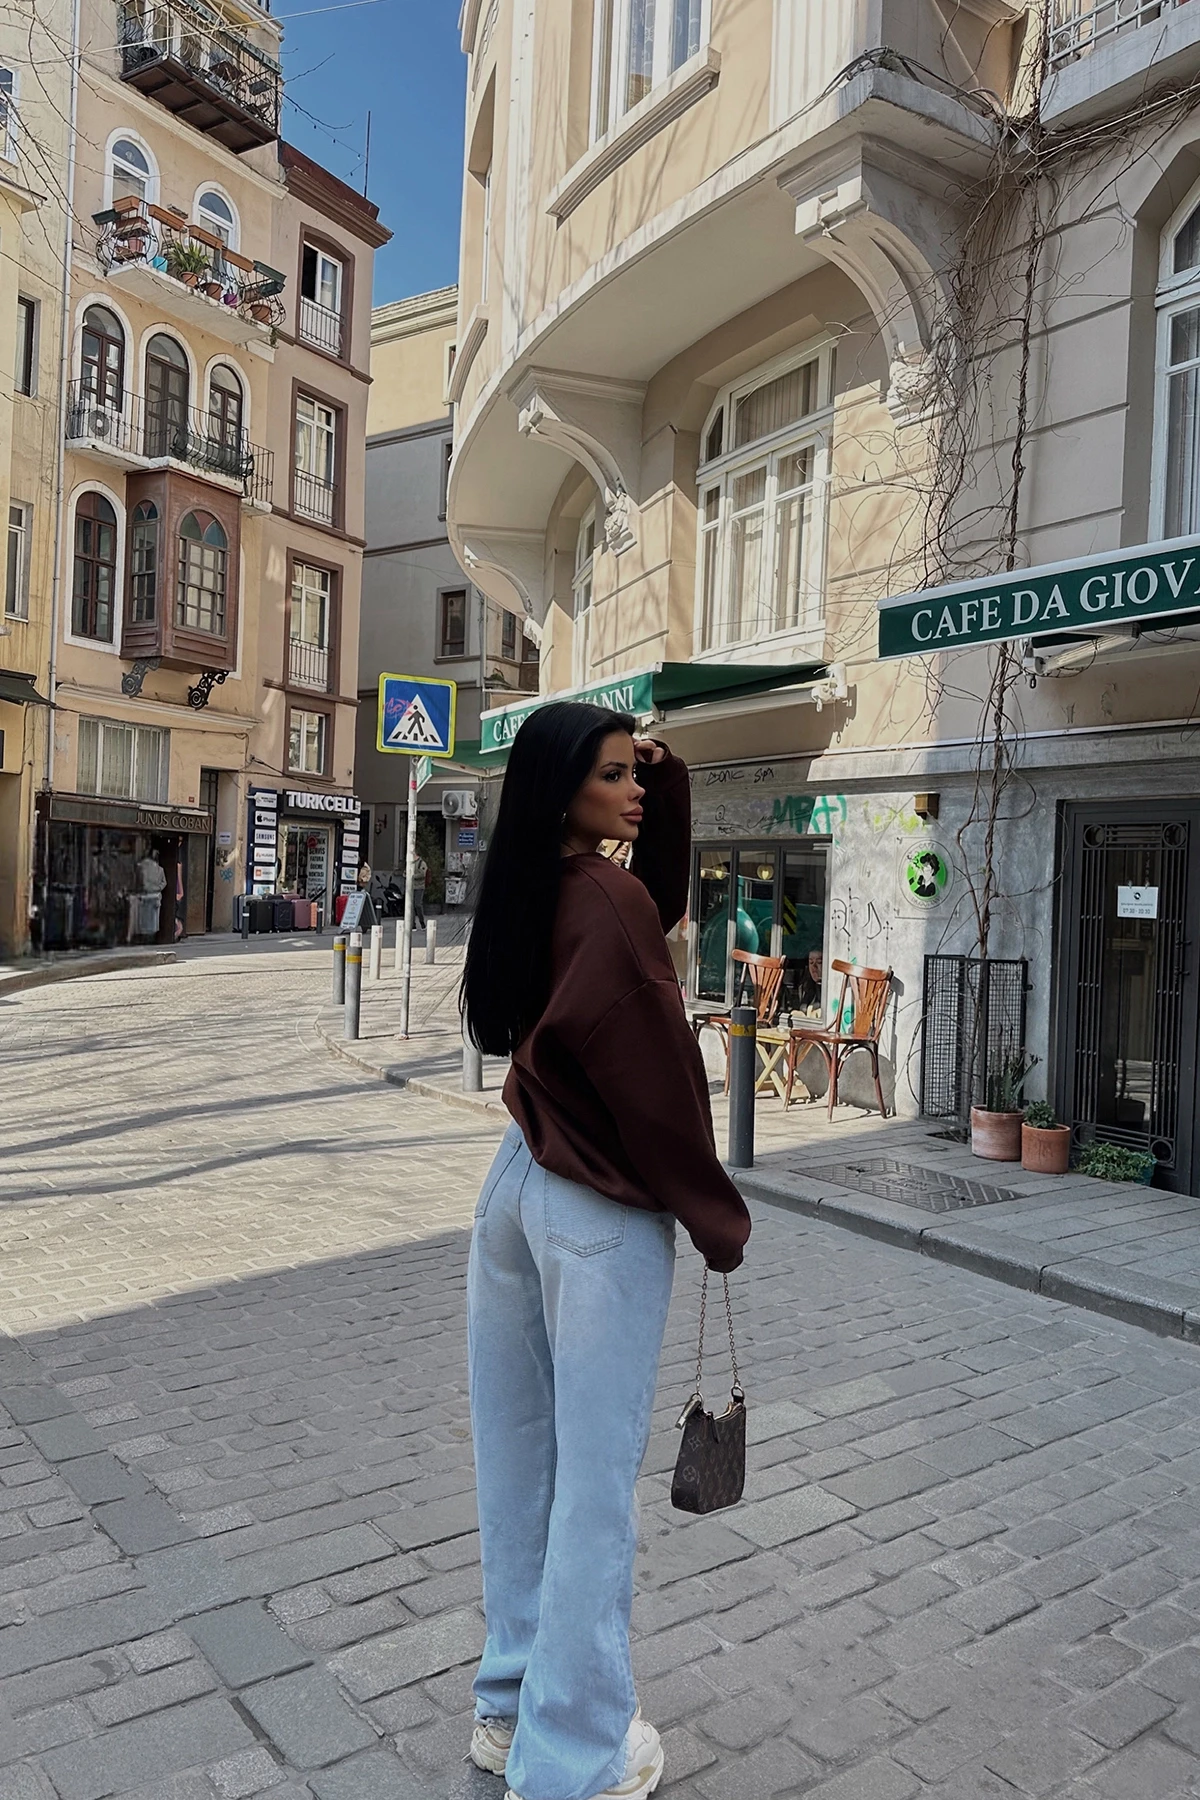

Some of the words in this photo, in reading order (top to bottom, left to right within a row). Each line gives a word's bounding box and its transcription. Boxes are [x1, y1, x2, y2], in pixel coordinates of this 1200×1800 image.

[911, 596, 1002, 642] CAFE
[1011, 584, 1071, 626] DA
[1079, 557, 1200, 613] GIOV
[286, 791, 356, 813] TURKCELL
[135, 811, 169, 827] JUNUS
[171, 815, 209, 831] COBAN
[255, 832, 275, 841] SAMSUNG
